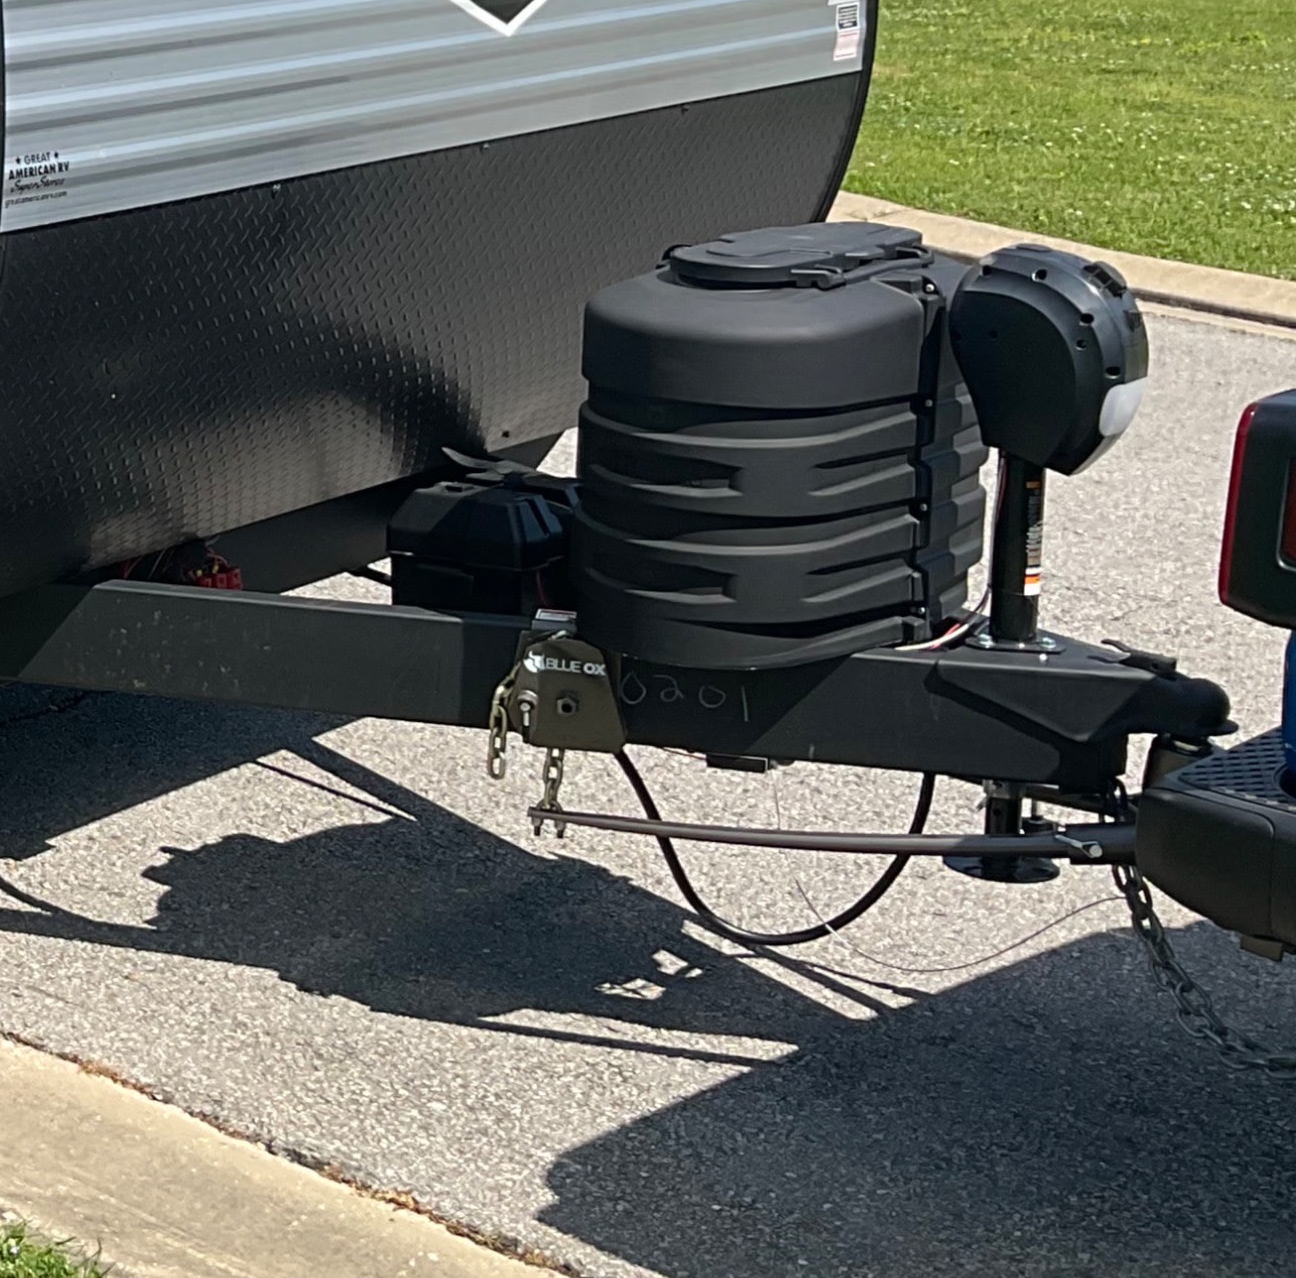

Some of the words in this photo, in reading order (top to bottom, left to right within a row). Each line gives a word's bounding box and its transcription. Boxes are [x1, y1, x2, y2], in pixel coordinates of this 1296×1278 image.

[24, 152, 51, 165] GREAT
[9, 162, 57, 180] AMERICAN
[58, 161, 70, 172] RV
[546, 657, 582, 673] BLUE
[583, 662, 606, 676] OX
